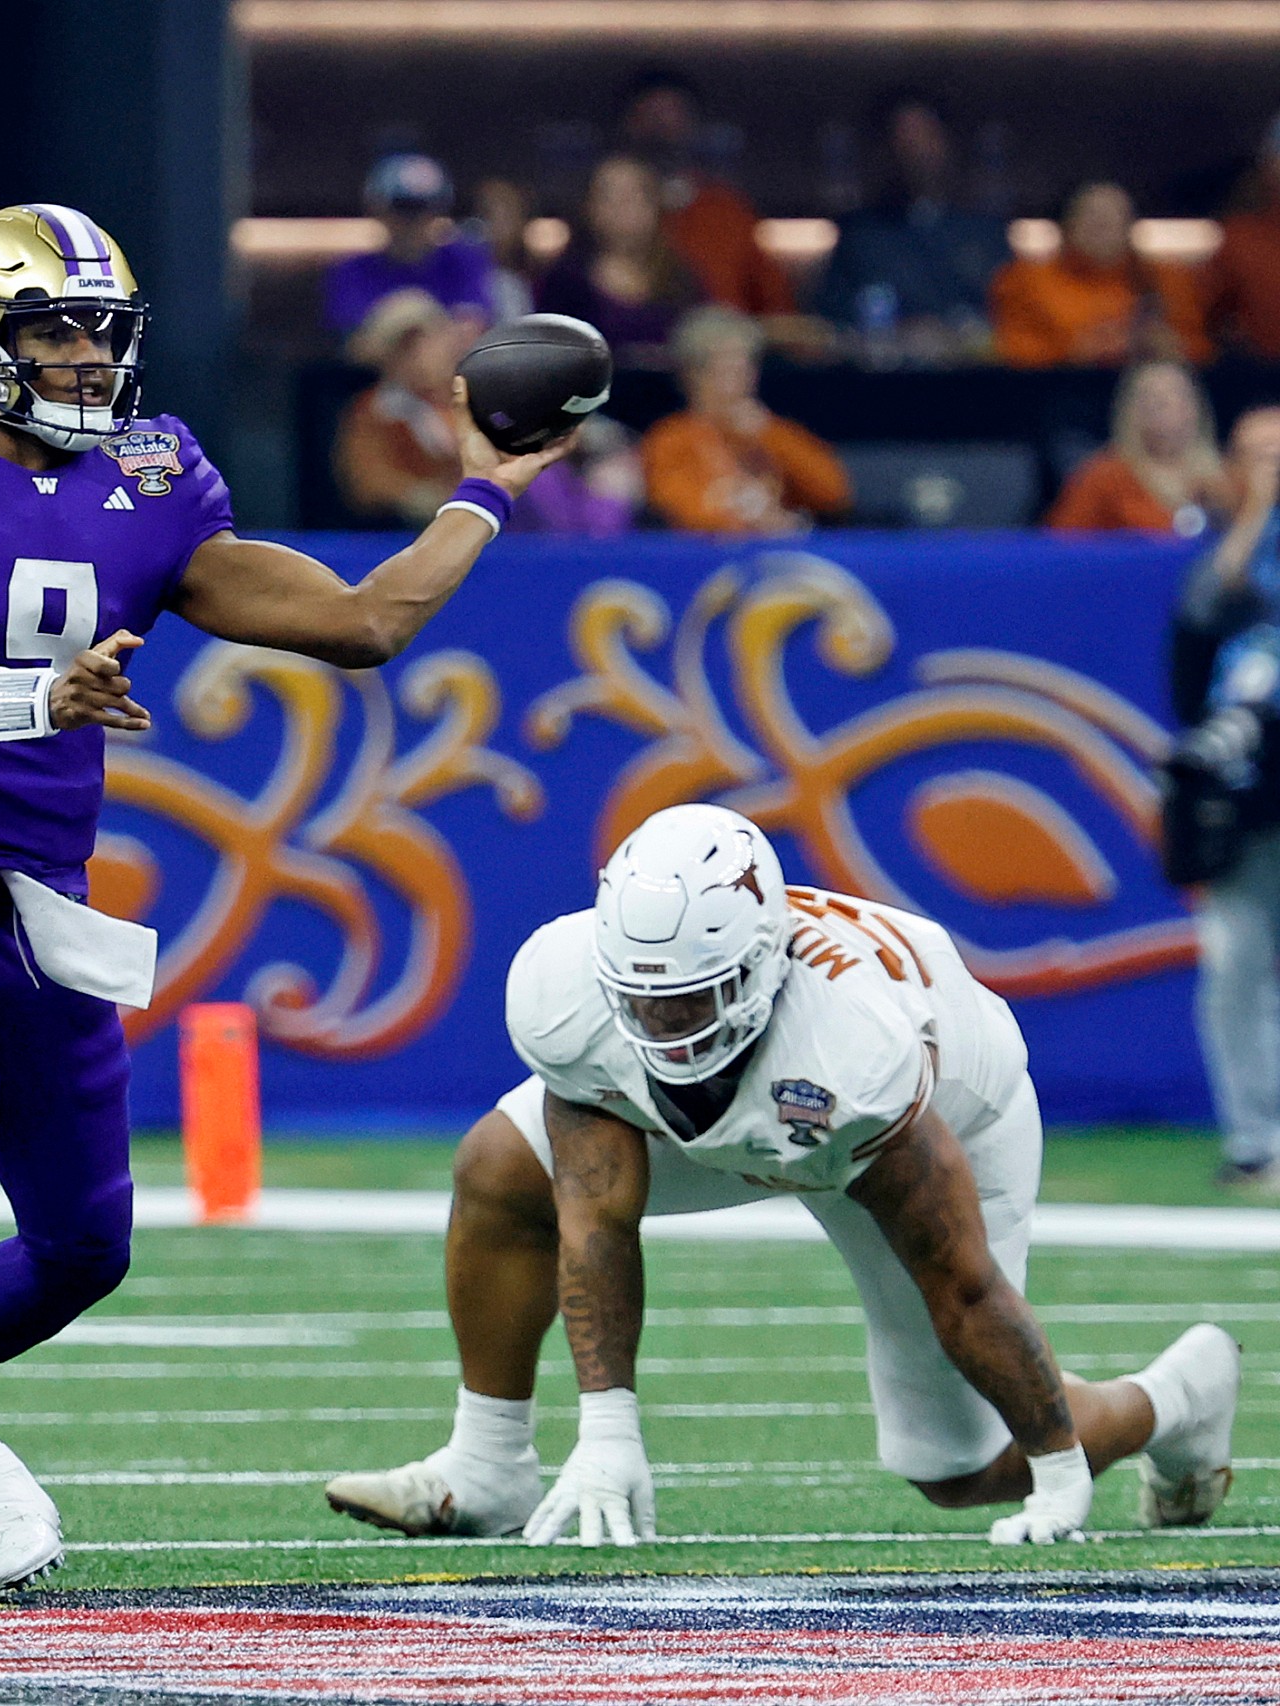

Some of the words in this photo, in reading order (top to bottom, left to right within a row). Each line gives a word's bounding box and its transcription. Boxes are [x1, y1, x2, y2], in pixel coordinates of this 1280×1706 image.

[119, 441, 167, 457] Allstate
[32, 477, 58, 495] W
[6, 557, 99, 676] 9
